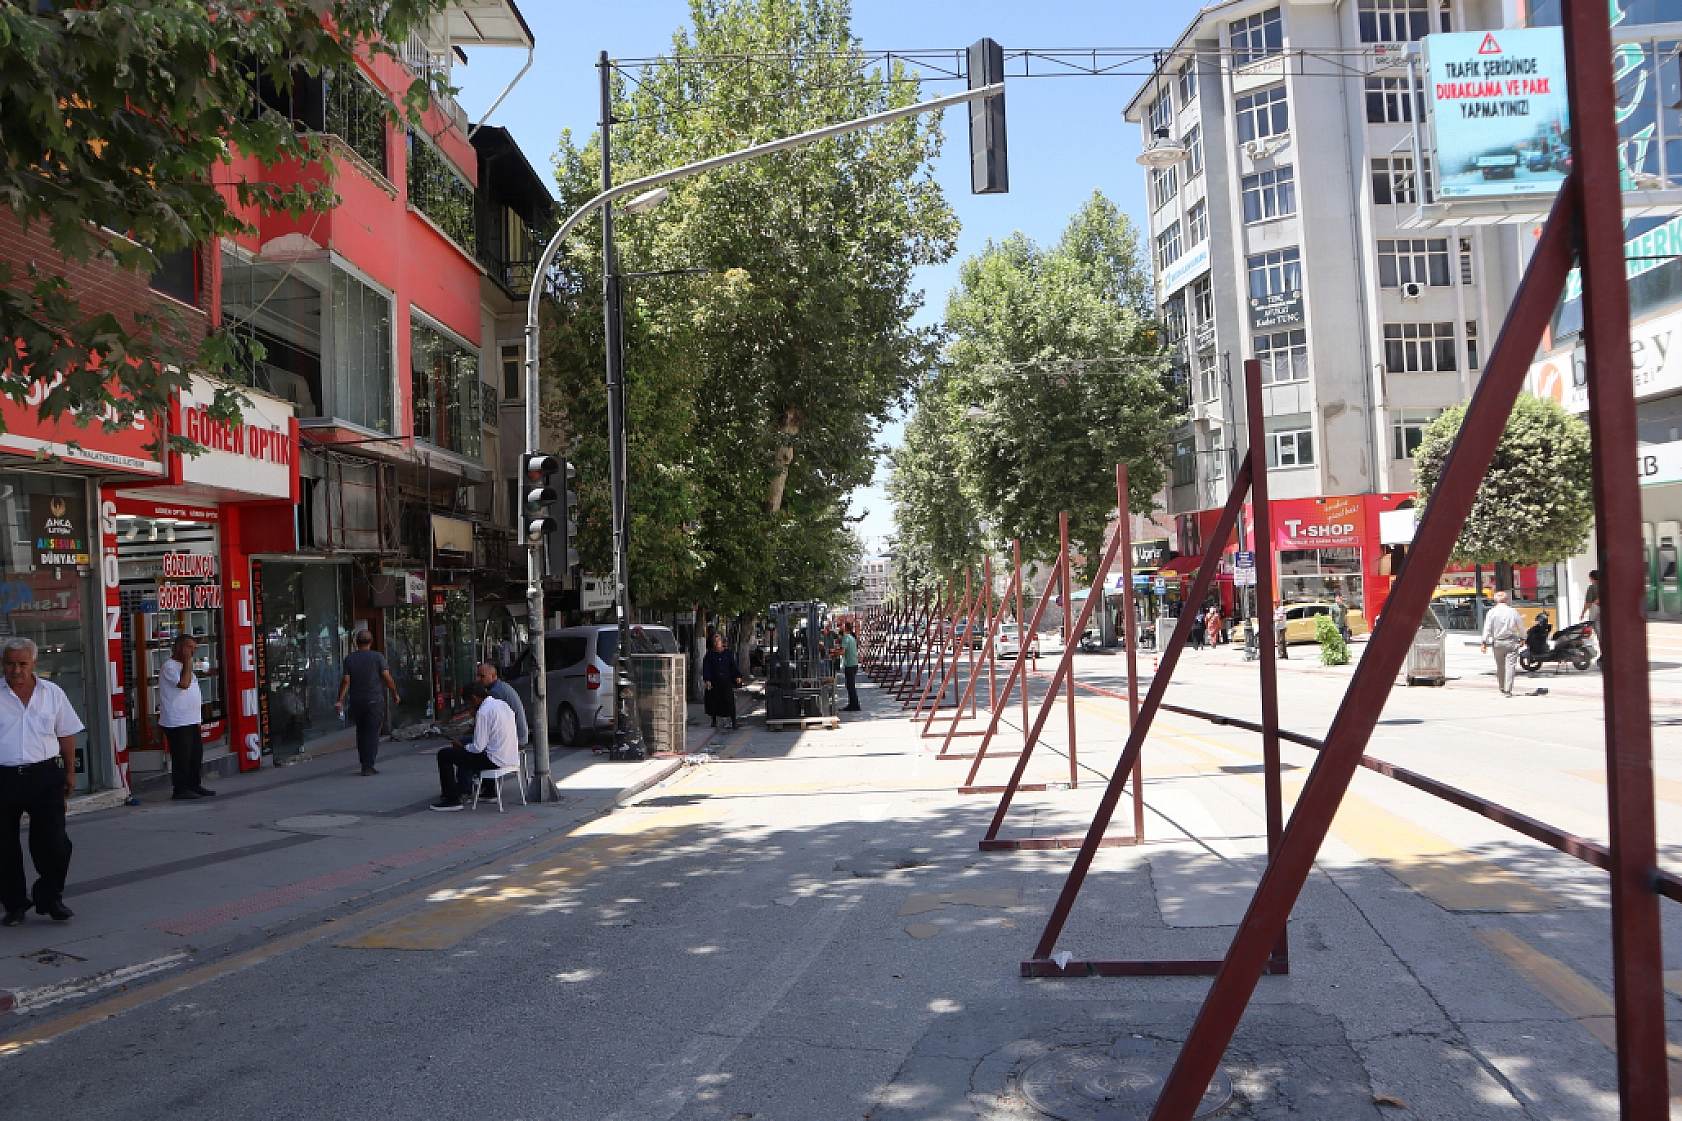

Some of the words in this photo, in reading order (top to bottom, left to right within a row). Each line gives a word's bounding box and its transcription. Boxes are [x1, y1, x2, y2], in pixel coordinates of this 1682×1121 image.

[1445, 57, 1480, 78] TRAFİK
[1484, 55, 1537, 80] ŞERİDİNDE
[1436, 81, 1502, 100] DURAKLAMA
[1506, 80, 1519, 96] VE
[1522, 78, 1550, 95] PARK
[187, 403, 244, 455] GÖREN
[249, 424, 290, 465] OPTİK
[41, 551, 76, 565] DÜNYAS
[159, 582, 191, 609] GÖREN
[194, 580, 222, 609] OPTİK
[238, 599, 260, 761] LENS
